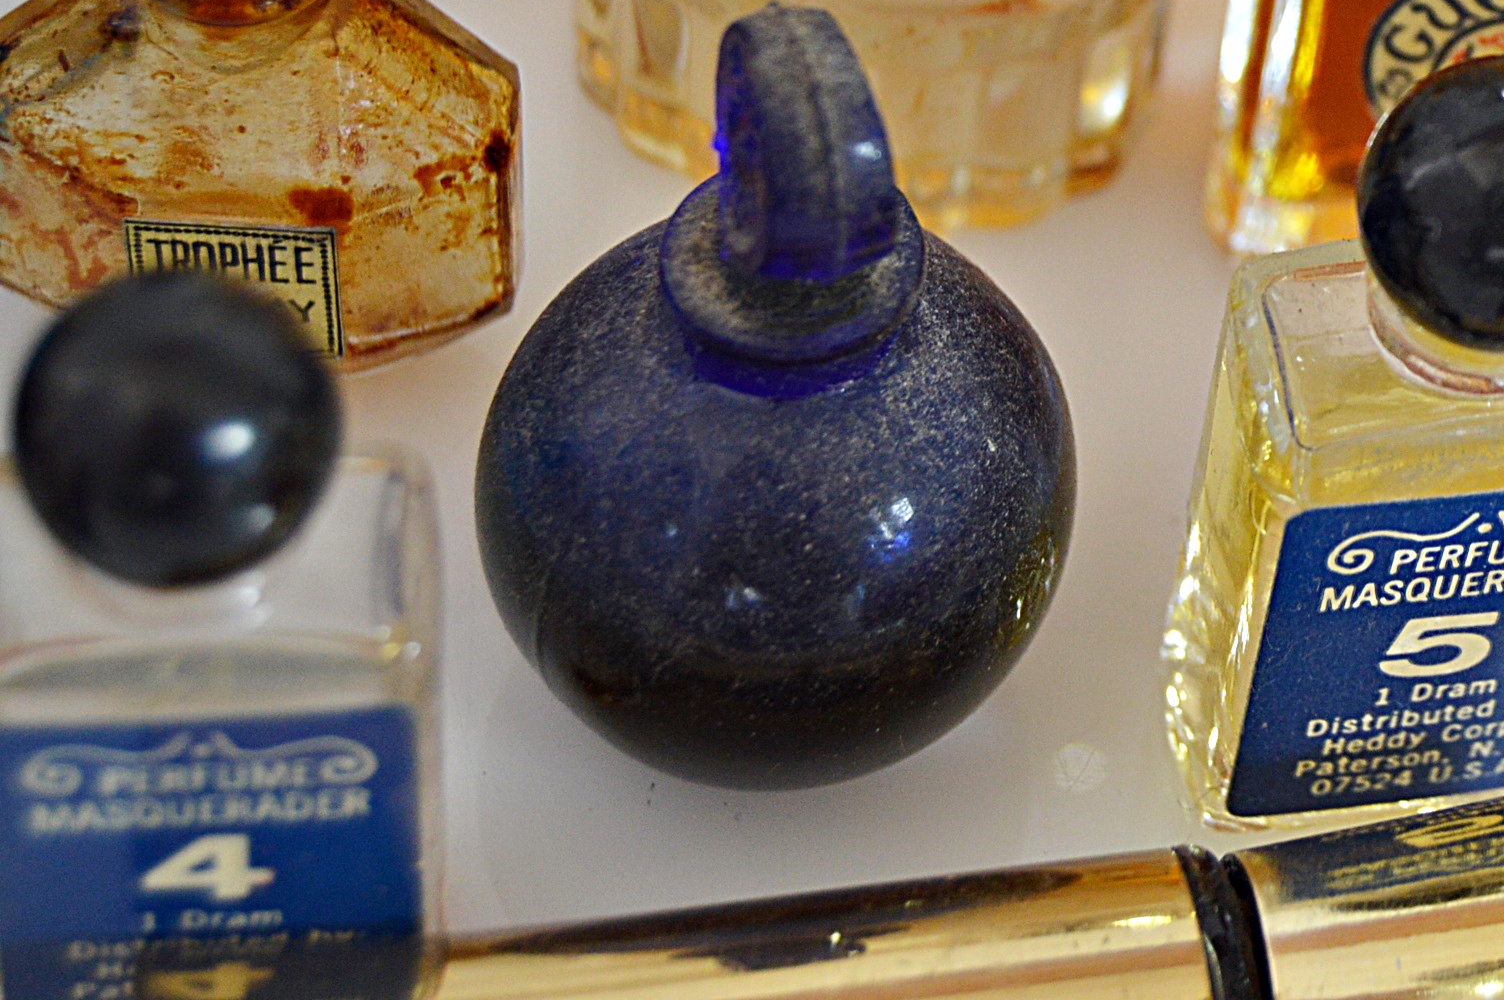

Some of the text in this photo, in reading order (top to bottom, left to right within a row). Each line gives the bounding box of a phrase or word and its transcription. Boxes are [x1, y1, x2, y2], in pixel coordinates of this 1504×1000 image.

[145, 237, 317, 284] TROPHÉE
[1378, 610, 1499, 678] 5
[1374, 678, 1498, 707] 1 Dram
[1306, 699, 1496, 737] Distributed
[1322, 730, 1427, 756] Heddy
[97, 760, 312, 796] PERFUME
[1295, 750, 1450, 778] Paterson,
[1310, 770, 1413, 796] 07524
[29, 786, 370, 834] MASQUERADER
[139, 833, 276, 900] 4
[180, 908, 284, 931] Dram
